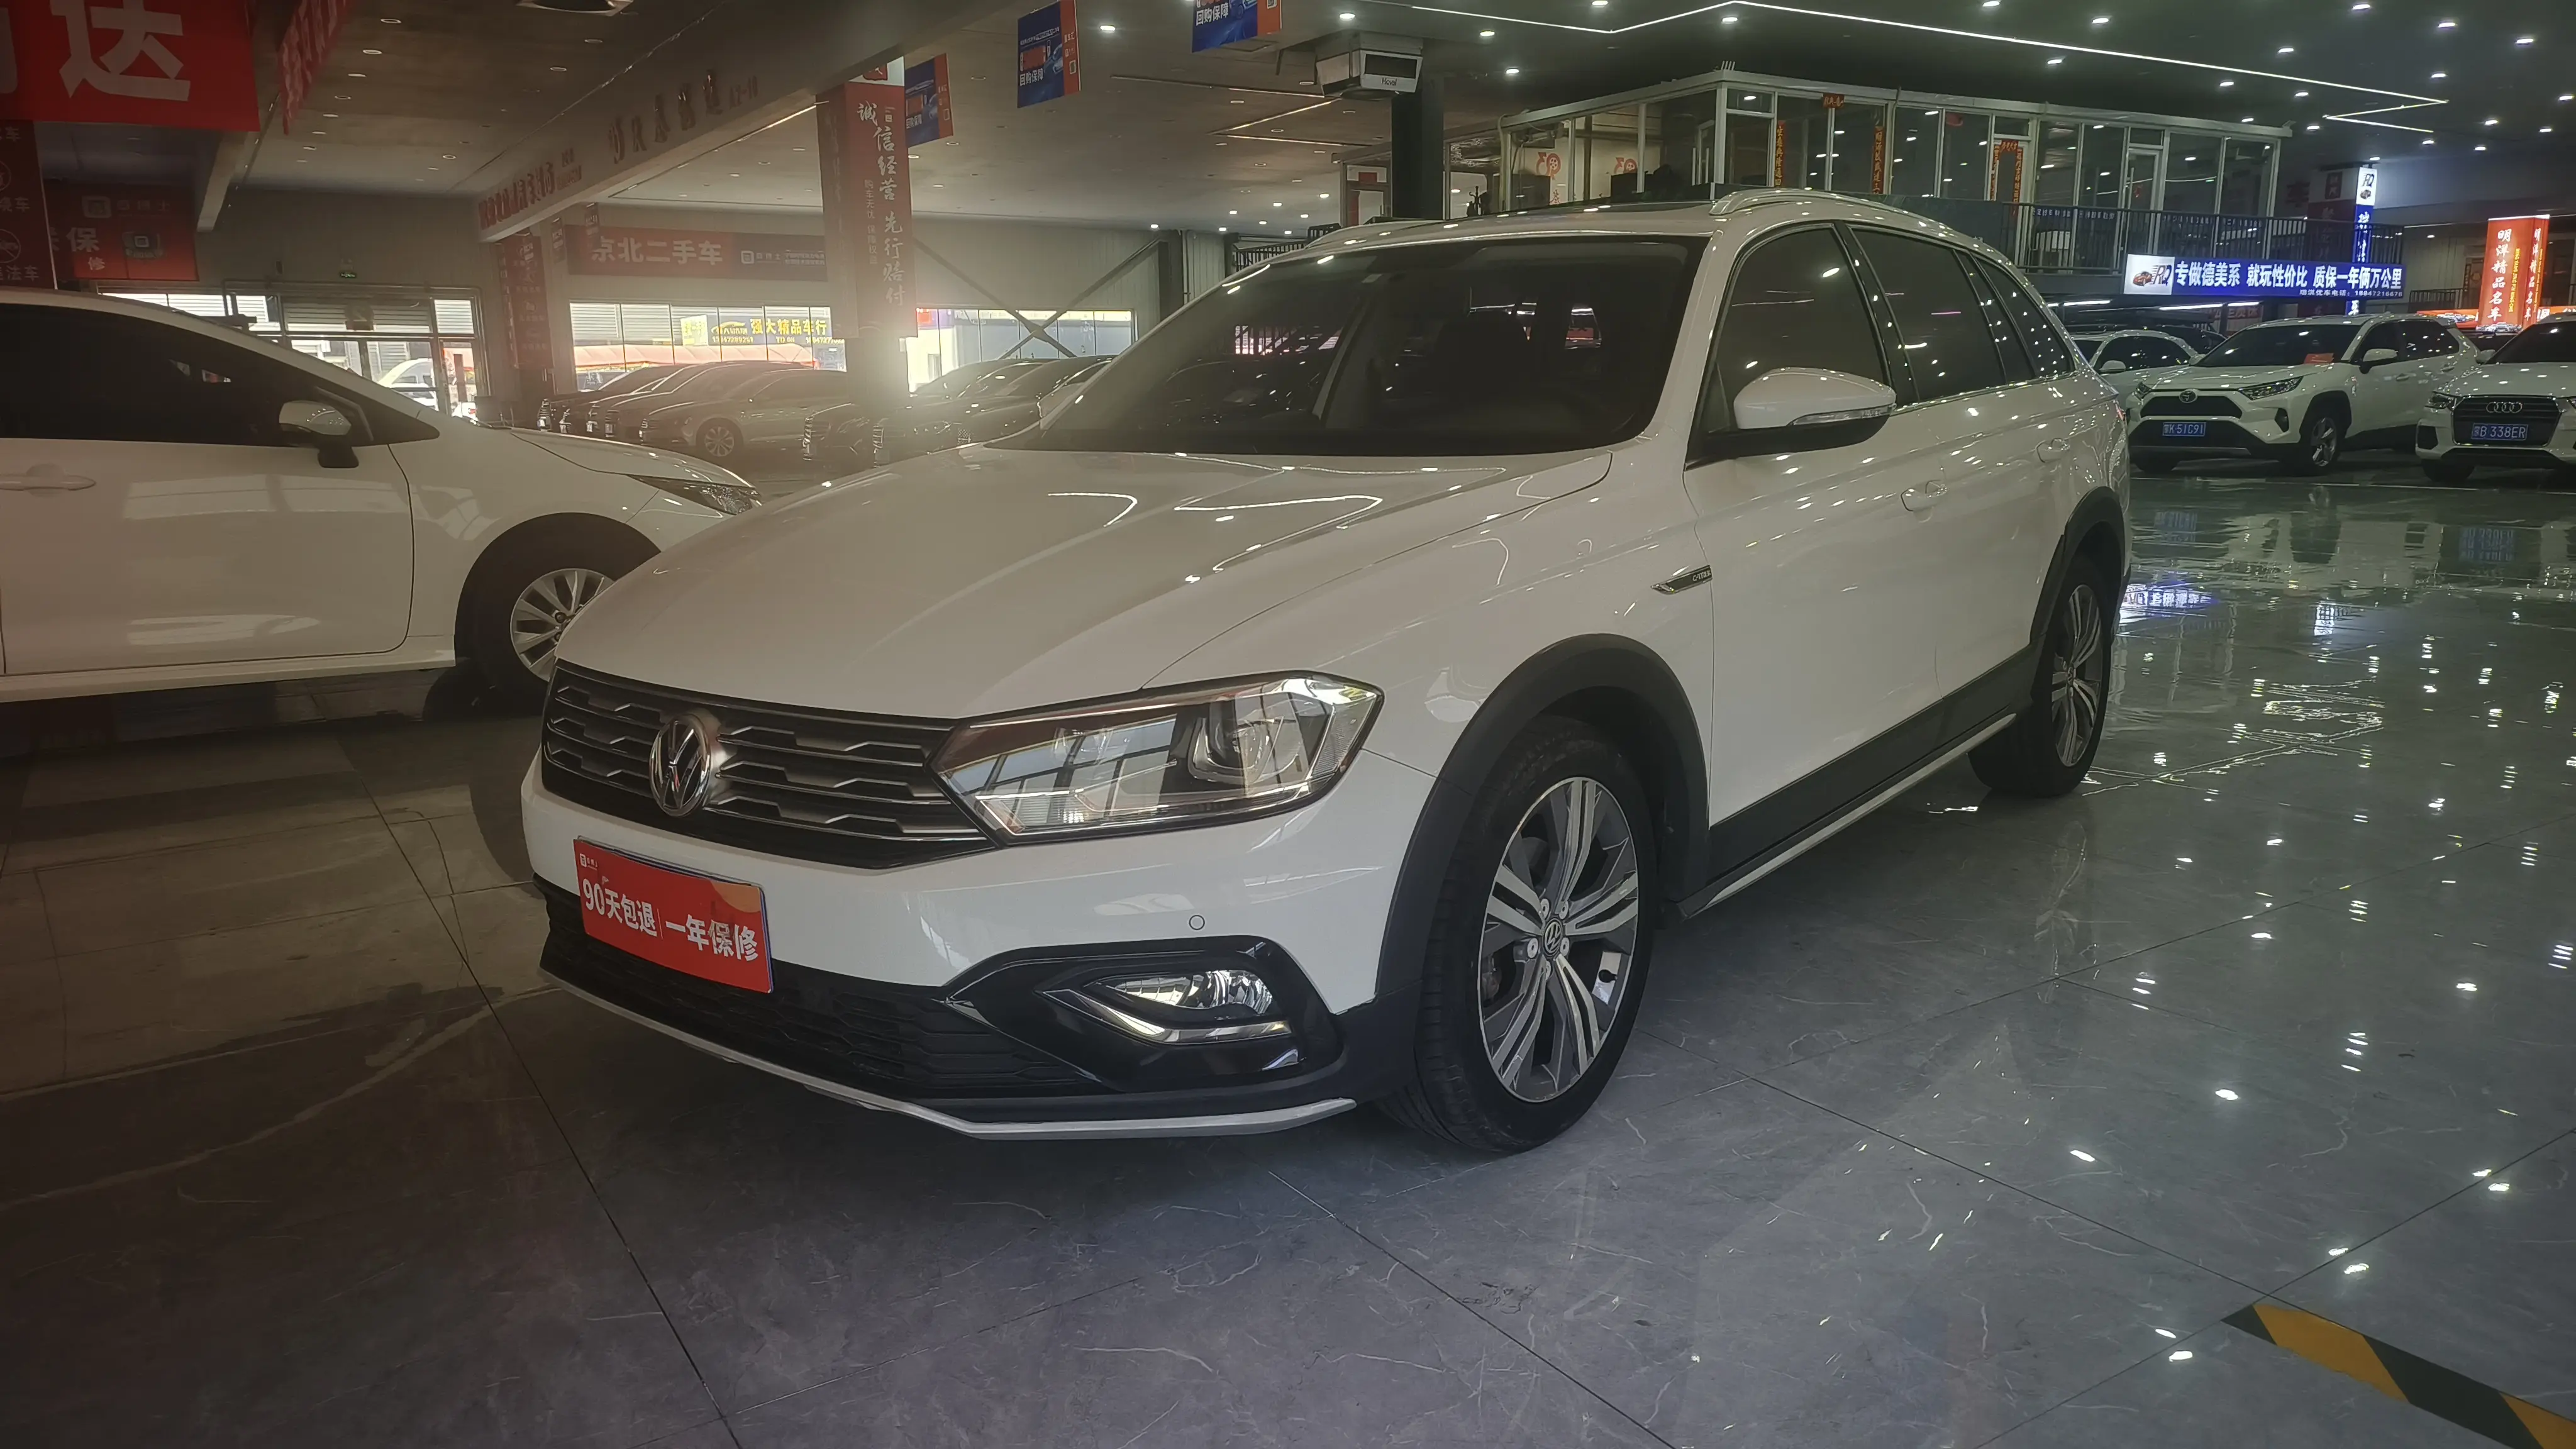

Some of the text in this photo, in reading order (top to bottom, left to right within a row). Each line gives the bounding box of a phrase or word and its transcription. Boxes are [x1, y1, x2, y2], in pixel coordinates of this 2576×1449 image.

[1196, 3, 1228, 26] 回购保障
[0, 0, 191, 101] 达
[1019, 68, 1043, 86] 回购保障
[856, 100, 906, 307] 诚信经营 先行赔付
[591, 235, 723, 265] 京北二手车
[2175, 261, 2402, 289] 专做德美系 就玩性价比 质保一年俩万公里
[2487, 229, 2512, 321] 明洋精品名车
[2524, 228, 2541, 321] 明洋精品名车
[750, 318, 828, 336] 强大精品车行
[582, 879, 758, 962] 90天包退 一年保修
